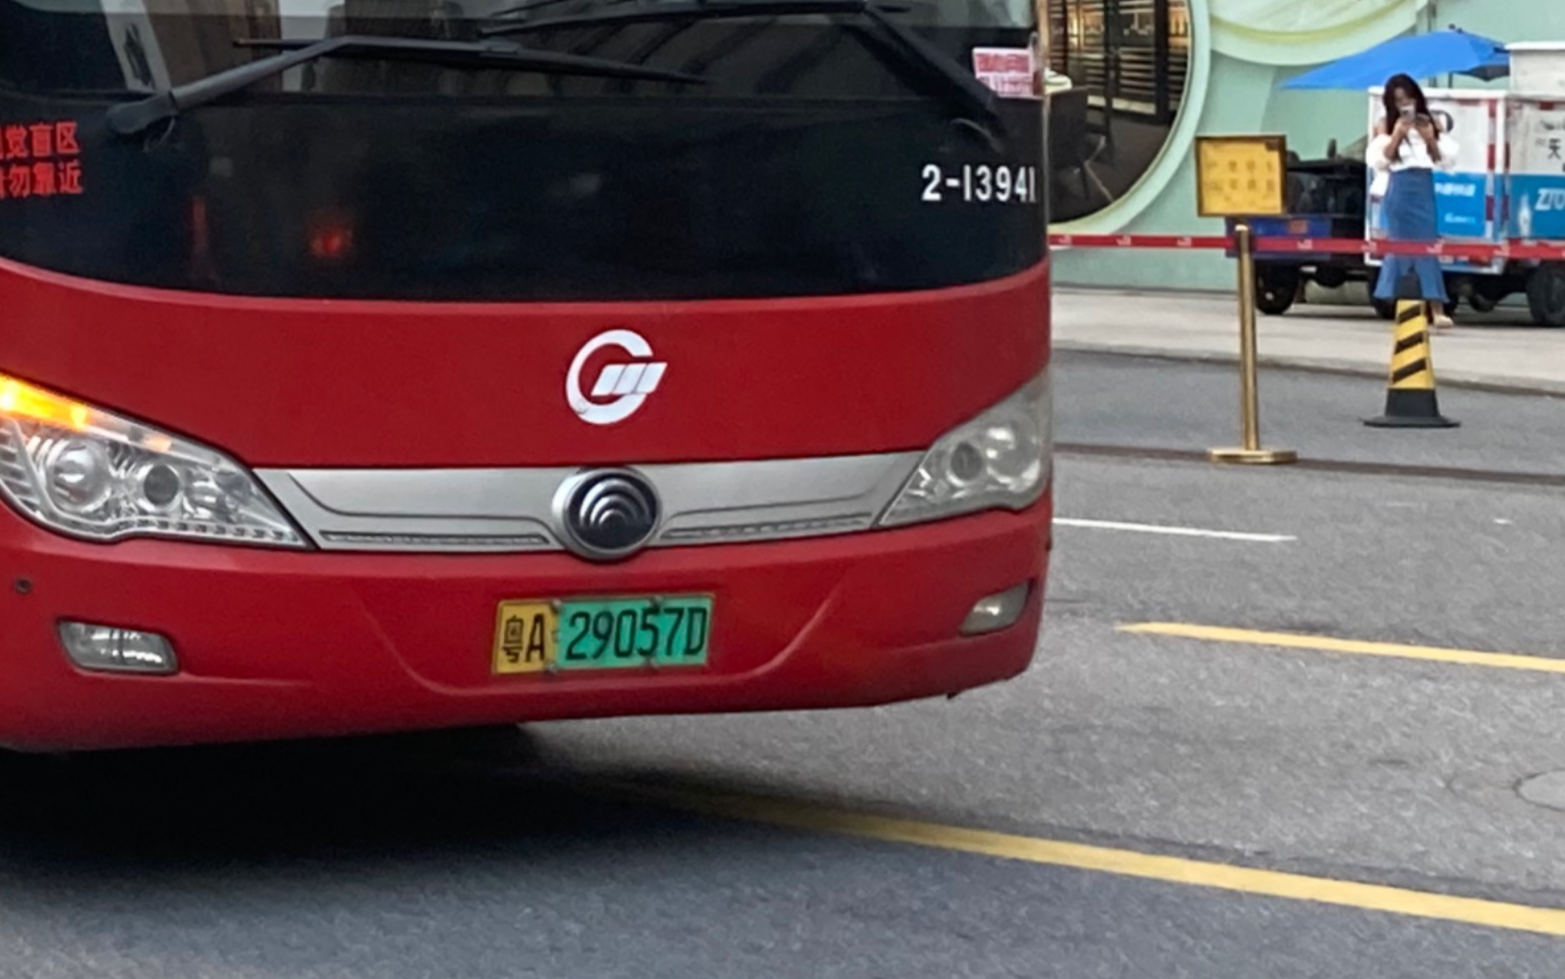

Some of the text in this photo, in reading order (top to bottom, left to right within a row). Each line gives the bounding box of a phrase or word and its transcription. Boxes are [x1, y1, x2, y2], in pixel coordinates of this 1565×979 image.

[921, 163, 1038, 204] 2-13941
[501, 607, 708, 664] 粤A 29057D
